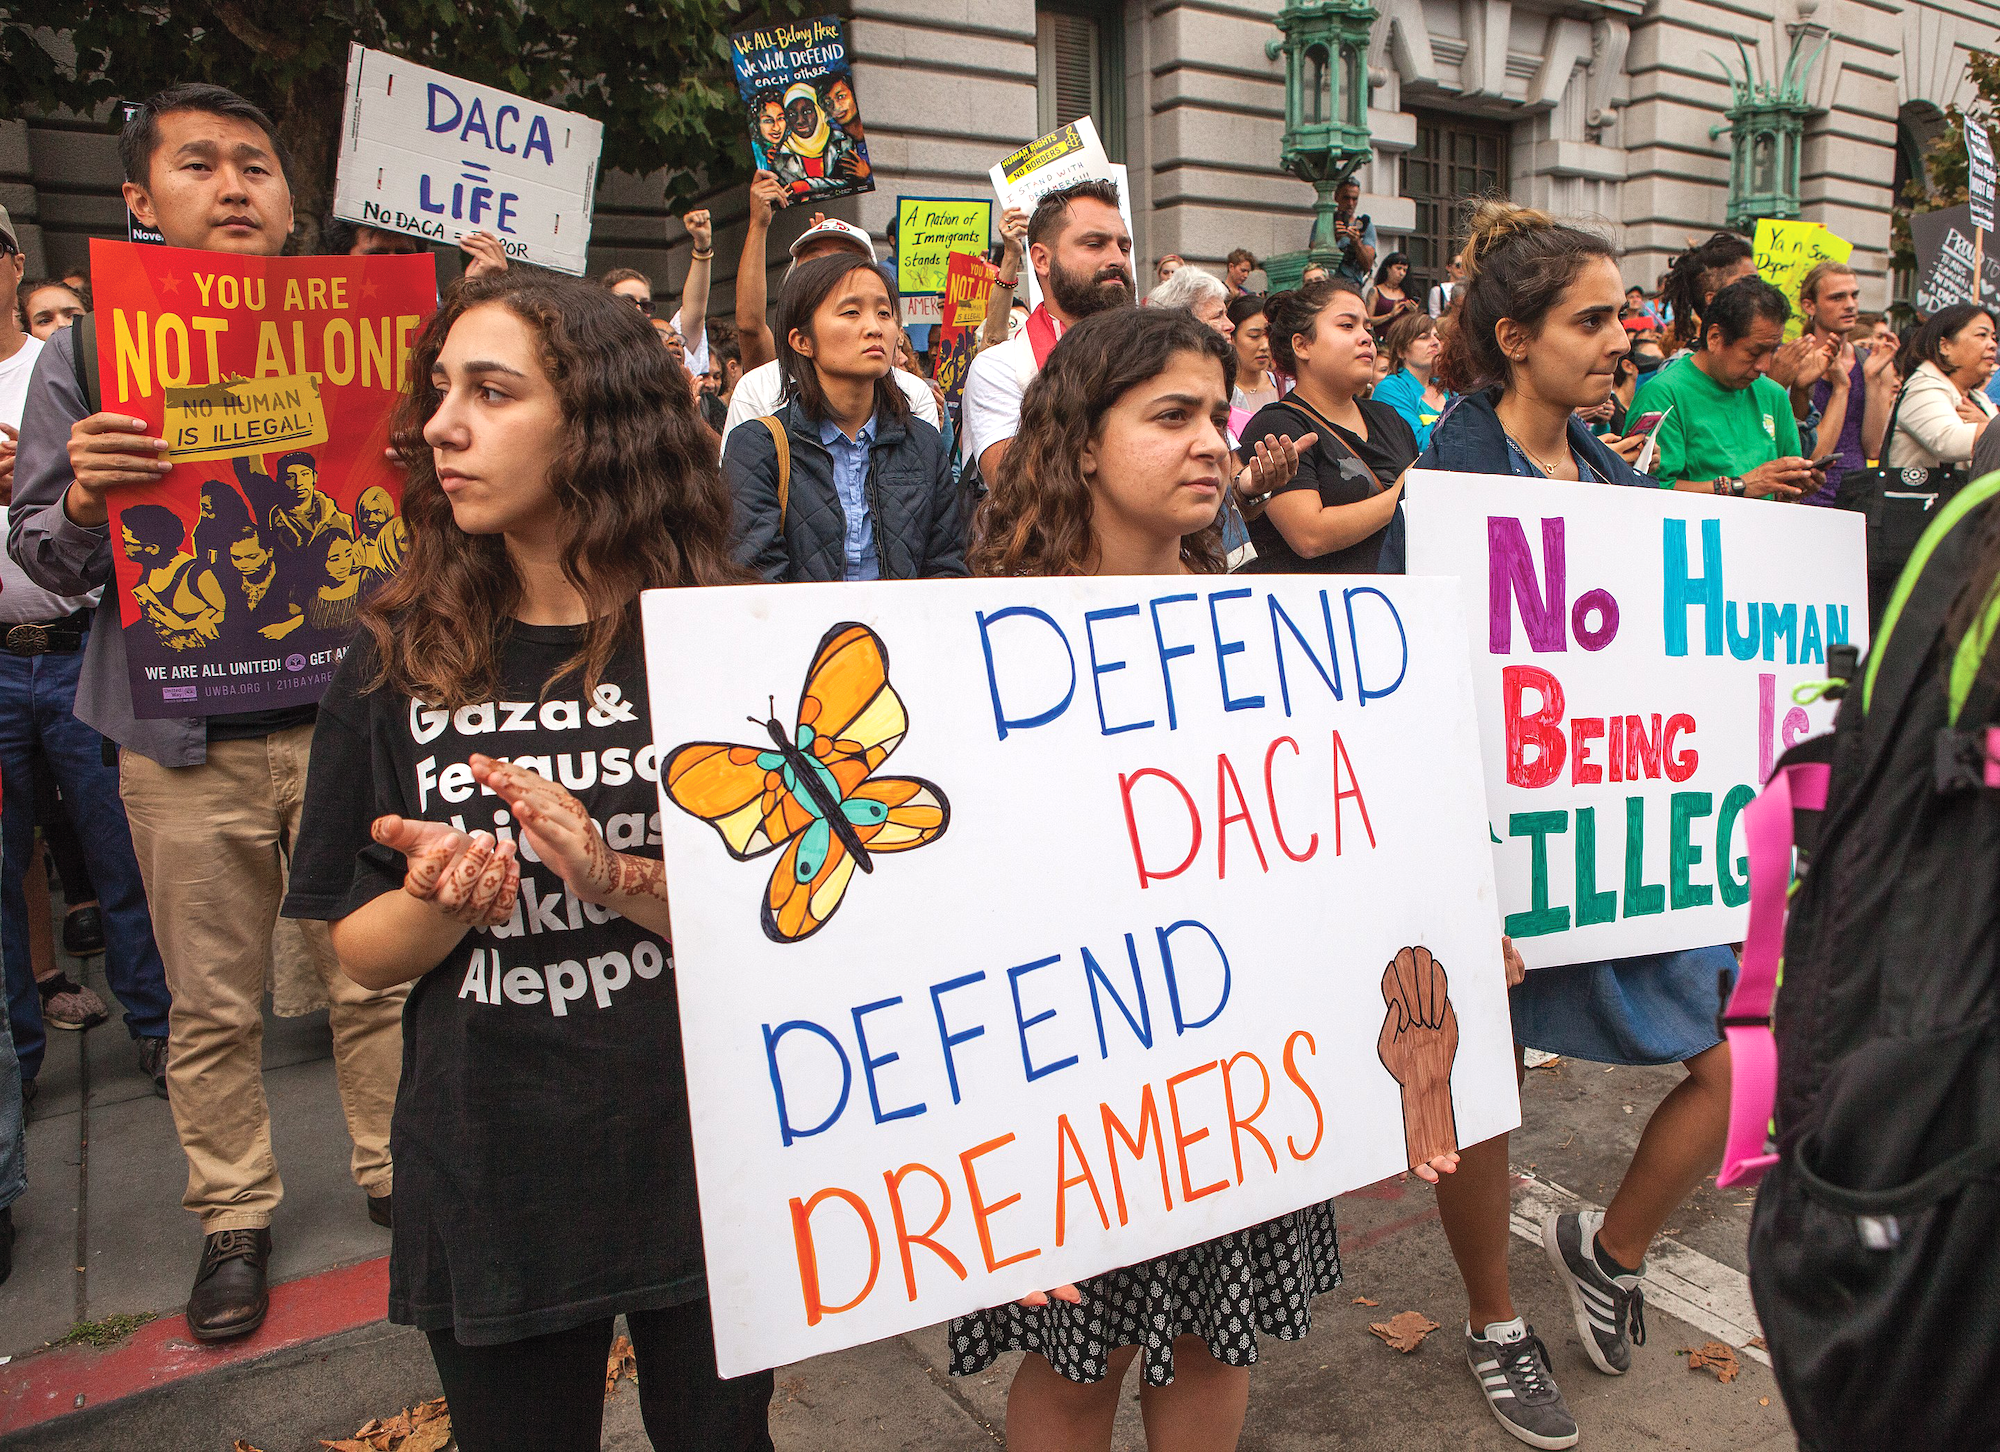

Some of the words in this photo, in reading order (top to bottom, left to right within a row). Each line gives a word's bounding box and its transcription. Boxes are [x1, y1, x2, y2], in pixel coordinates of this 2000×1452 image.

[734, 36, 754, 55] We
[754, 32, 777, 51] ALL
[775, 24, 813, 49] Belong
[737, 58, 758, 78] We
[758, 51, 789, 73] Will
[426, 82, 554, 166] DACA
[1001, 147, 1029, 168] HUMAN
[1029, 133, 1058, 152] RIGHTS
[1013, 168, 1025, 180] NO
[1026, 147, 1062, 172] BORDERS
[1019, 175, 1053, 195] STAND
[1057, 162, 1085, 178] WITH
[419, 174, 519, 234] LIFE
[905, 206, 919, 227] A
[963, 212, 979, 226] of
[132, 228, 165, 242] Nove
[396, 211, 444, 240] DACA
[912, 230, 980, 249] Immigrants
[904, 252, 941, 267] stands
[970, 262, 984, 278] YOU
[193, 272, 266, 311] YOU
[283, 277, 349, 311] ARE
[948, 272, 975, 305] NOT
[908, 297, 940, 316] AMER
[113, 308, 229, 403] NOT
[254, 314, 421, 395] ALONE
[183, 398, 213, 419] NO
[224, 388, 301, 417] HUMAN
[177, 427, 199, 446] IS
[213, 412, 314, 443] ILLEGAL!
[145, 665, 168, 680] WE
[171, 665, 198, 680] ARE
[202, 663, 227, 678] ALL
[229, 658, 282, 676] UNITED!
[309, 649, 332, 666] GET
[975, 587, 1407, 741] DEFEND
[204, 682, 261, 698] UWBA.ORG
[276, 670, 332, 692] 211BAYARE
[409, 683, 639, 745] Gaza&
[1502, 664, 1699, 789] BEING
[415, 743, 658, 814] Feuso
[1117, 730, 1376, 889] DACA
[1504, 784, 1757, 939] ILLEG
[761, 919, 1231, 1147] DEFEND
[789, 1030, 1324, 1327] DREAMERS
